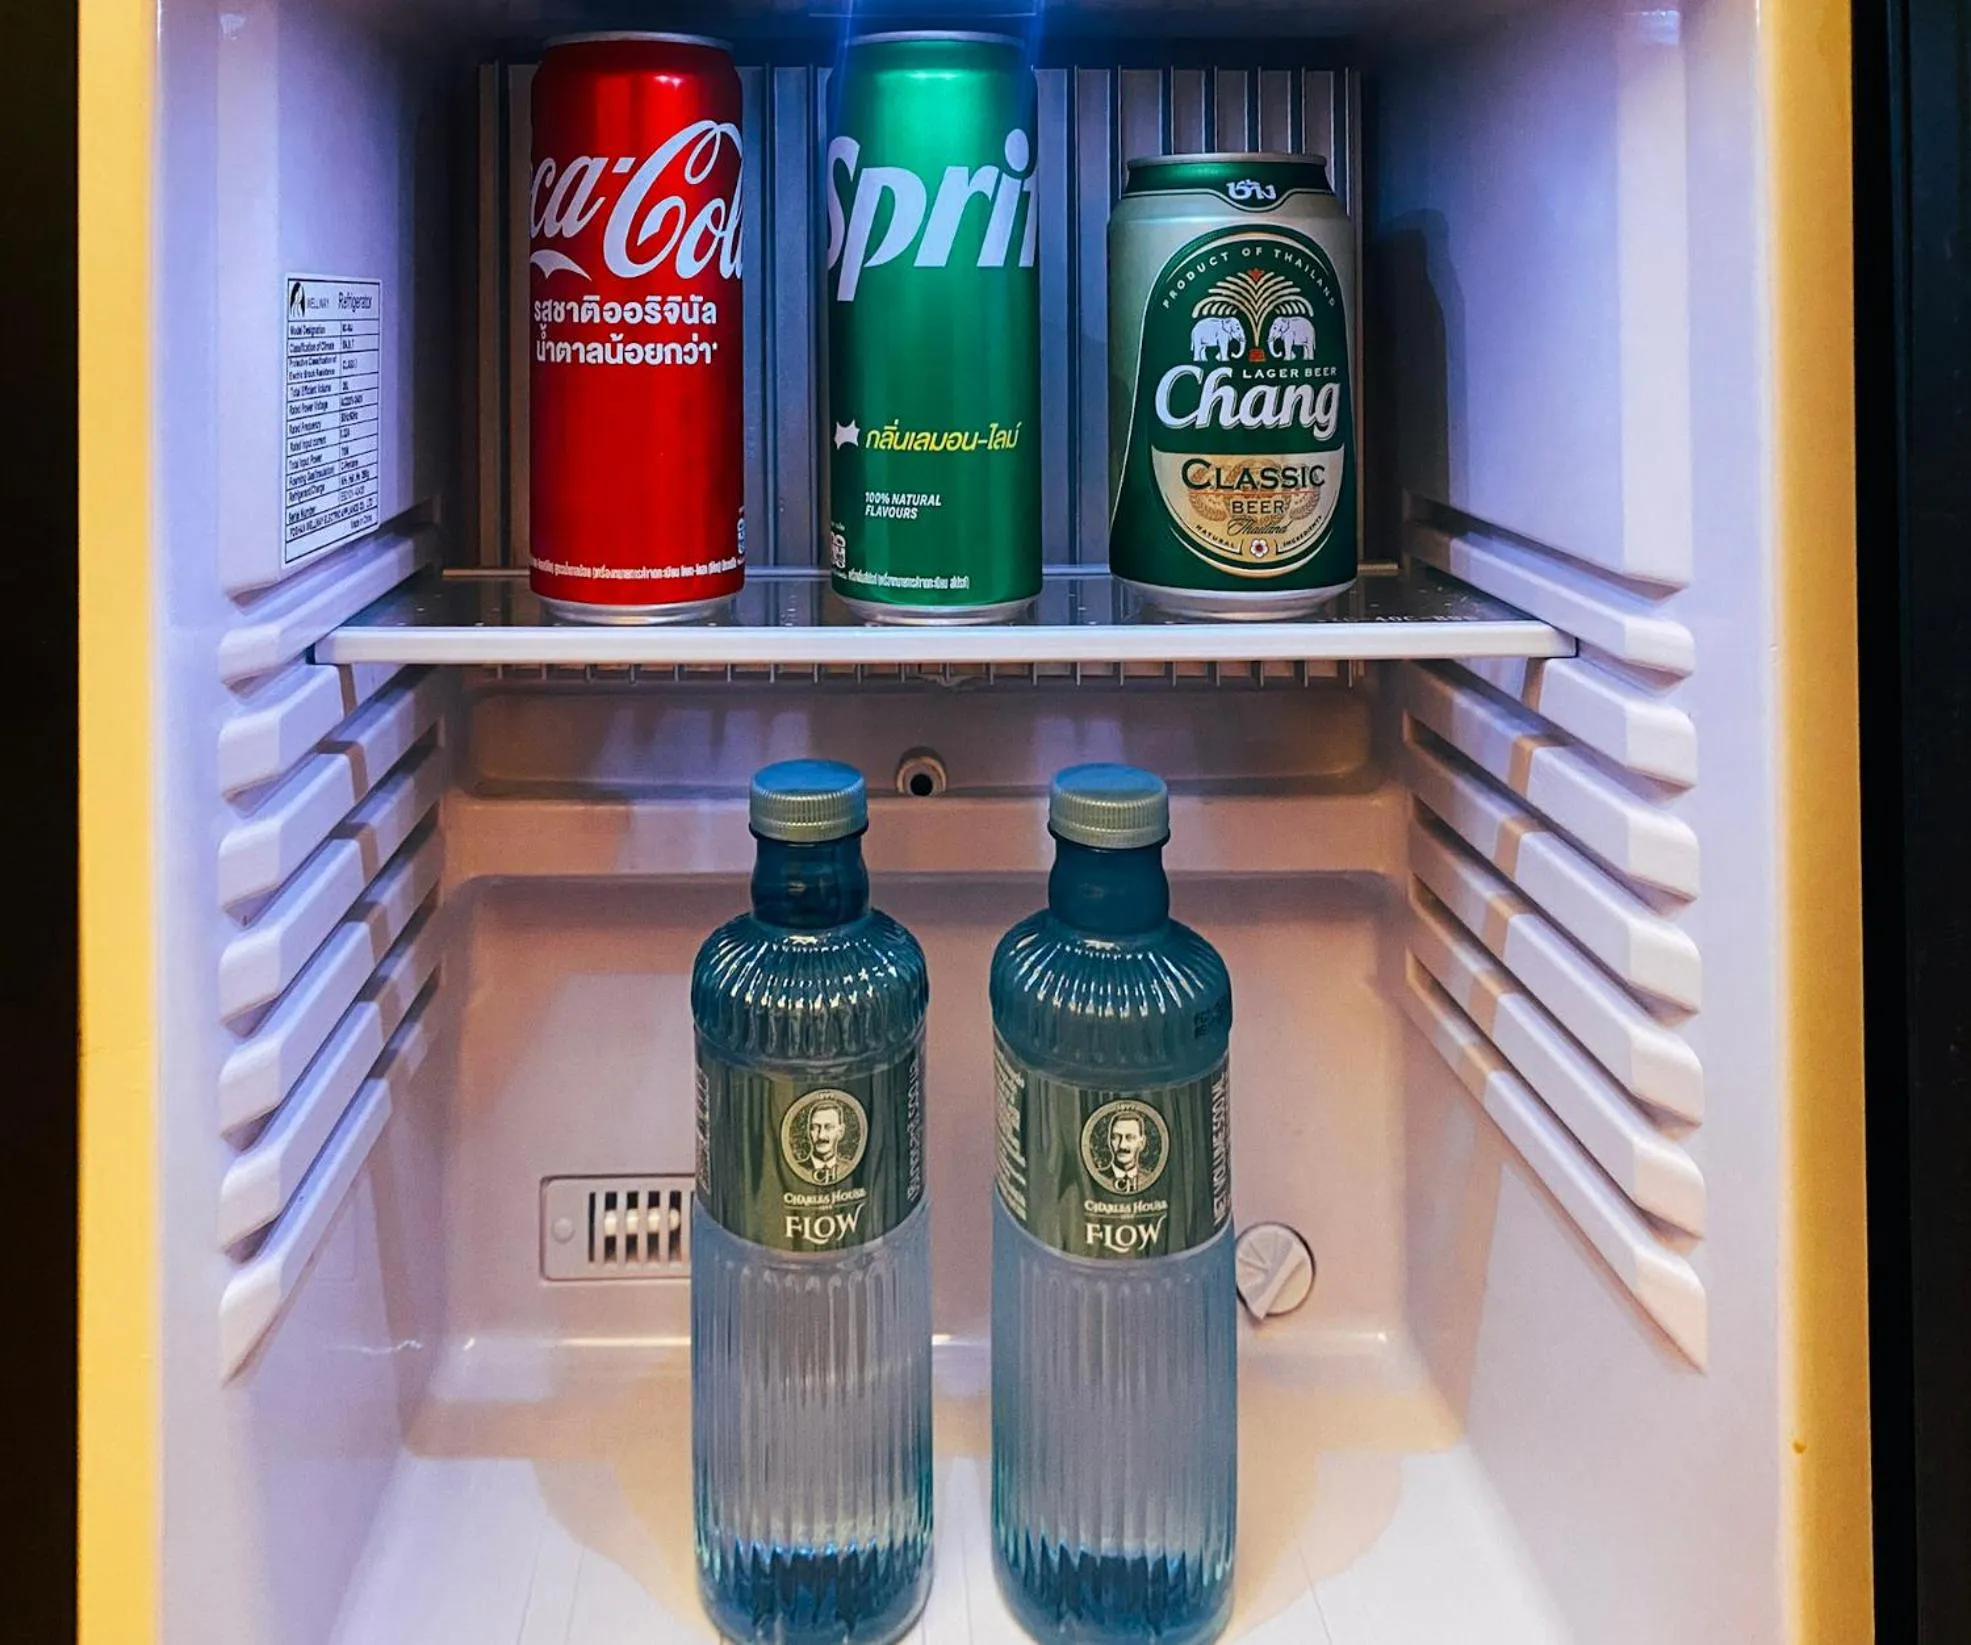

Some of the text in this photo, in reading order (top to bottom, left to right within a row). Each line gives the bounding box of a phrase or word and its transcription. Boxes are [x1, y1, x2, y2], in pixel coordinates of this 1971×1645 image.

[1163, 247, 1336, 309] PRODUCT OF THAILAND
[534, 294, 717, 325] รสชาติออริจินัล
[1242, 366, 1337, 380] LAGER BEER
[1155, 364, 1341, 442] Chang
[866, 418, 1022, 452] กลิ่นเลมอน-ไลม์
[1180, 457, 1325, 490] CLASSIC
[865, 491, 941, 506] 100% NATURAL
[865, 504, 918, 519] FLAVOURS
[1232, 500, 1286, 514] BEER
[1195, 524, 1236, 548] NATURAL
[785, 1203, 865, 1245] FLOW
[1086, 1214, 1167, 1252] FLOW
